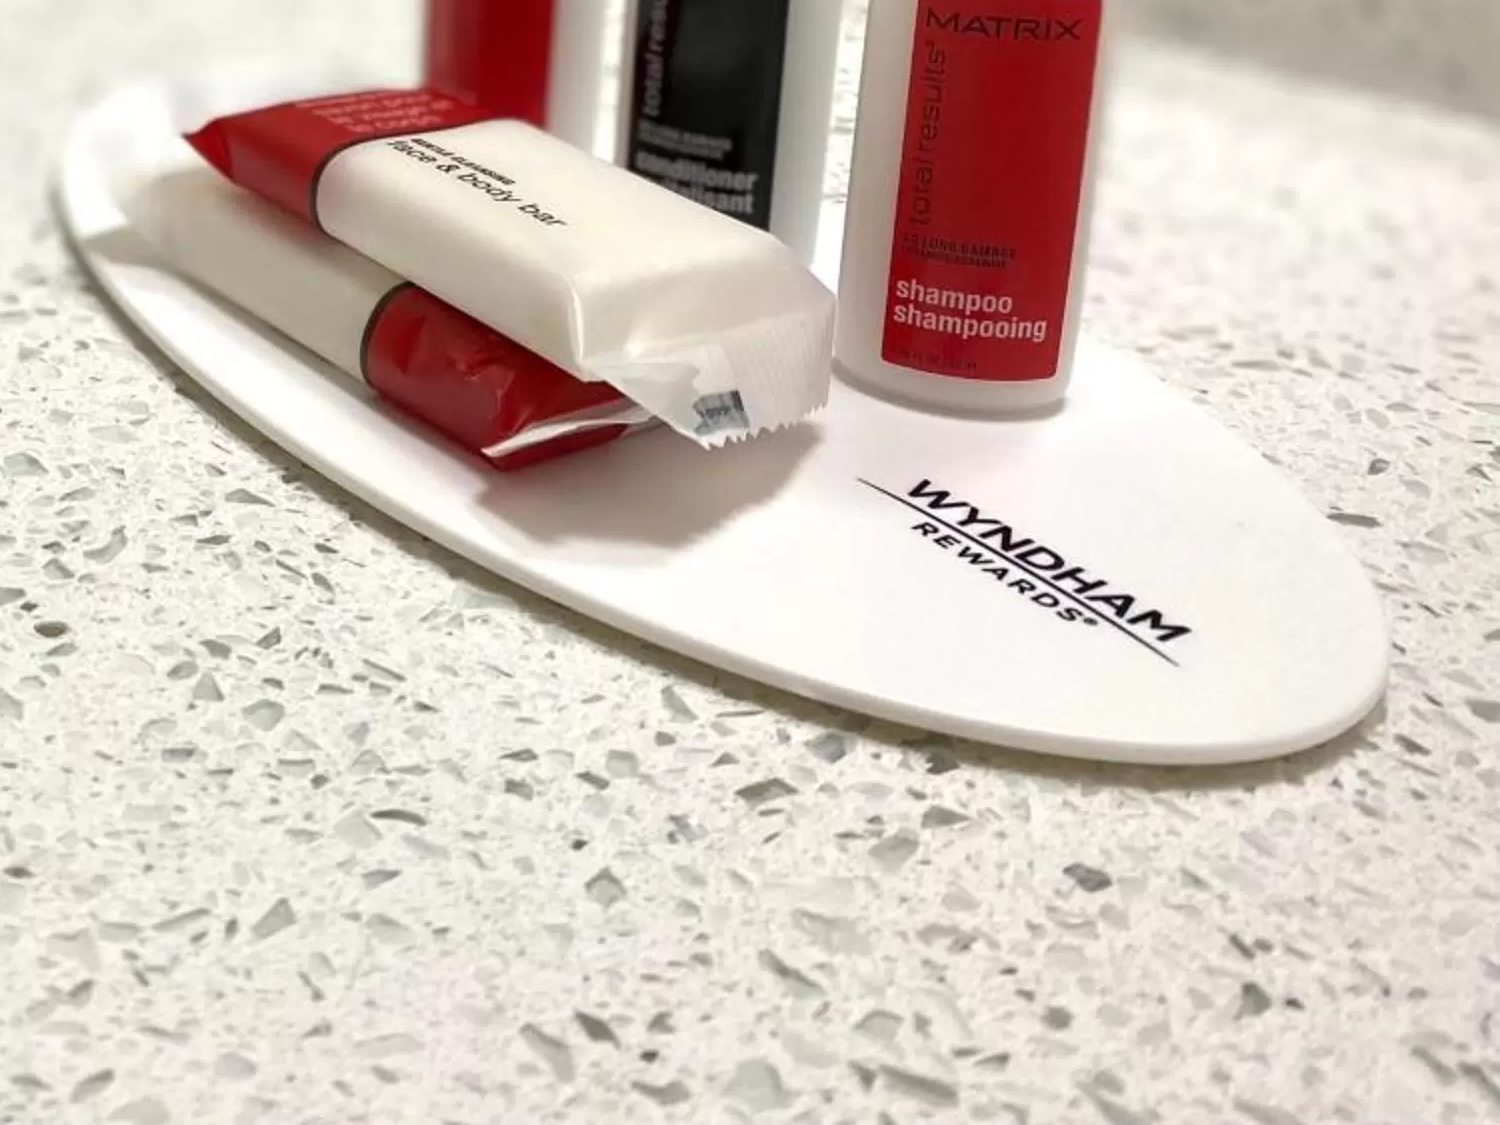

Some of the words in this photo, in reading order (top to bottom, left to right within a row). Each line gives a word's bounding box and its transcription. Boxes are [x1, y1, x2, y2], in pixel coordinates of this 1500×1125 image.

[926, 7, 1082, 41] MATRIX
[388, 140, 437, 163] face
[436, 164, 460, 173] &
[457, 172, 522, 202] body
[518, 203, 568, 226] bar
[896, 278, 1013, 316] shampoo
[893, 305, 1047, 341] shampooing
[907, 479, 1192, 642] WYNDHAM
